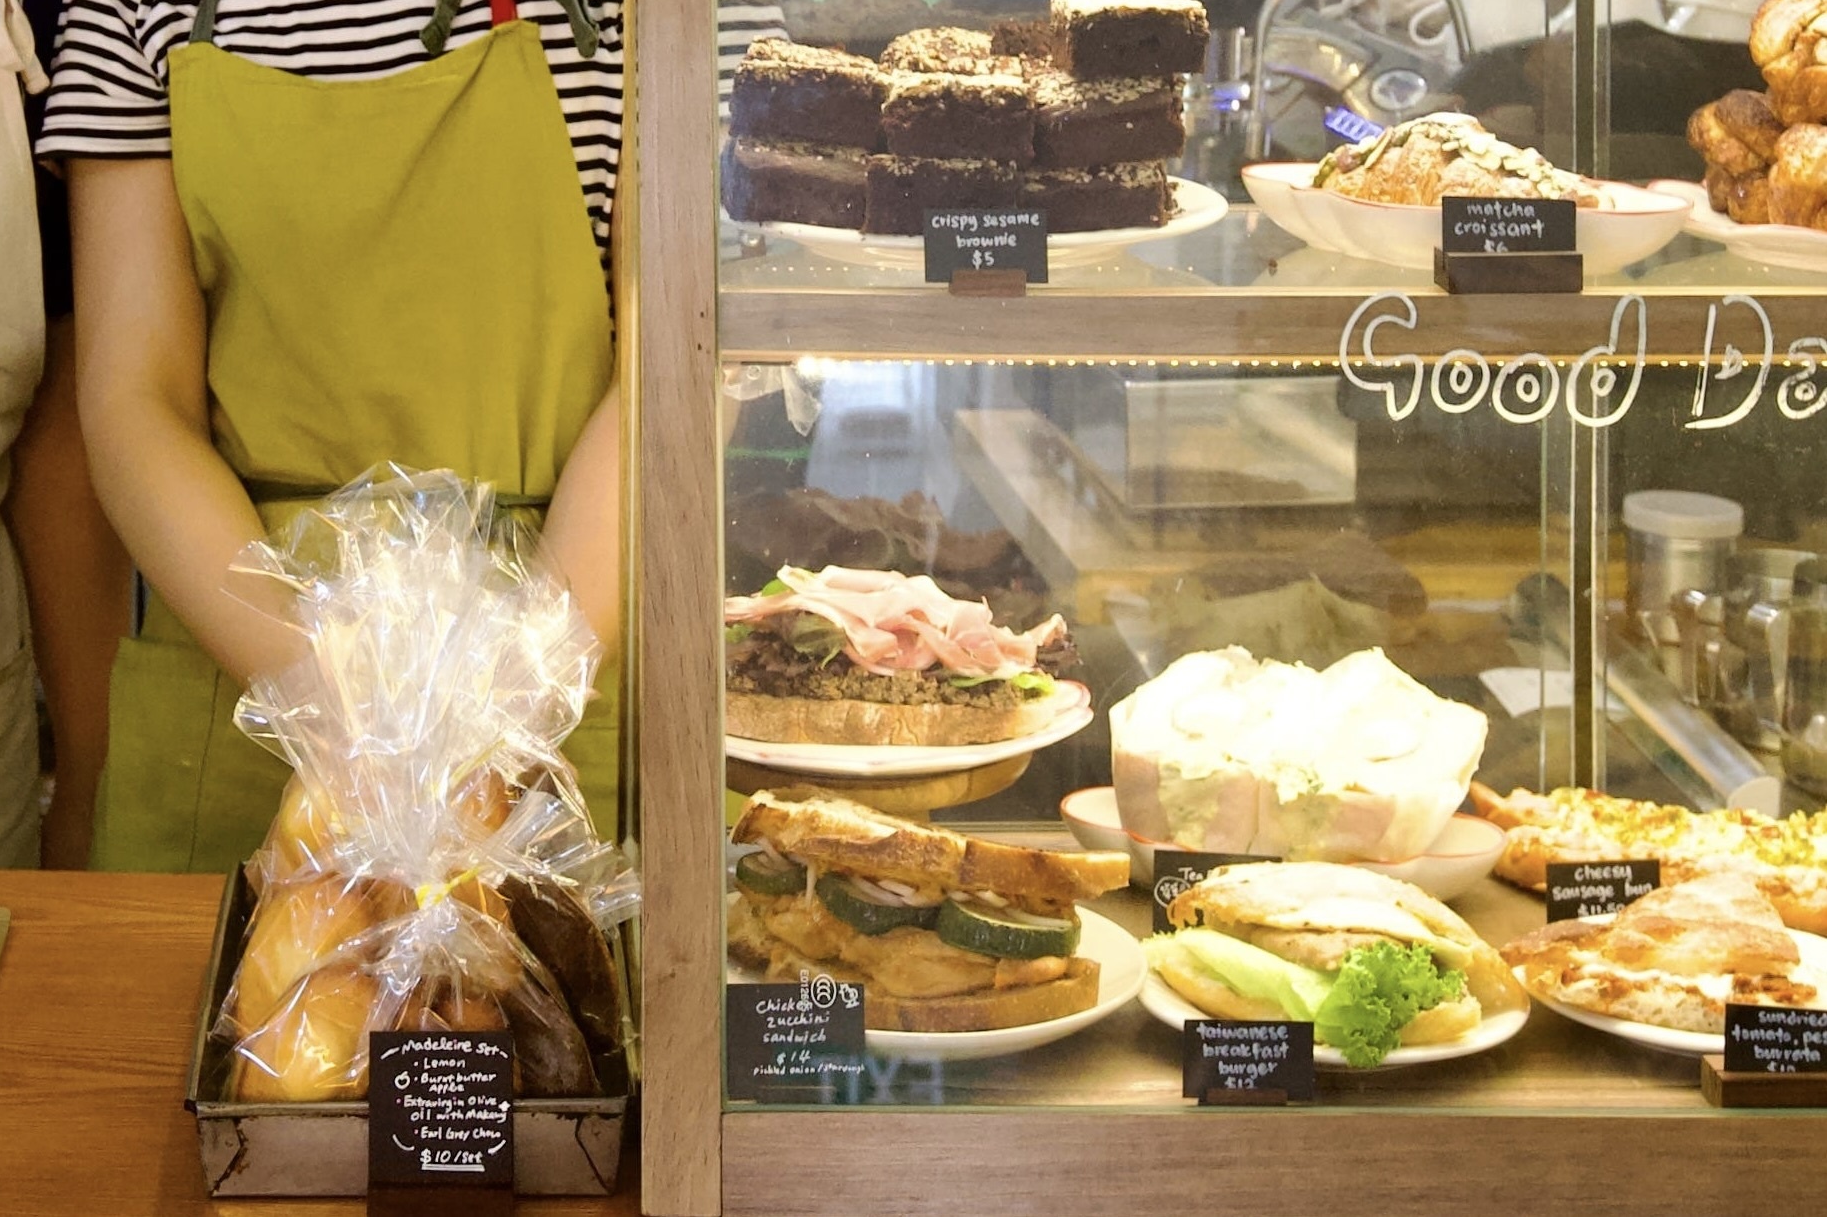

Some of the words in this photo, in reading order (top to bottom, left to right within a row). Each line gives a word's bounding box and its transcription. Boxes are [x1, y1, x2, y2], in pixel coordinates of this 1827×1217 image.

[1466, 200, 1535, 220] matcha
[931, 213, 978, 231] crispy
[983, 213, 1040, 228] sesame
[1454, 218, 1545, 239] croissant
[955, 232, 1017, 248] brownie
[971, 250, 995, 270] $5
[1339, 291, 1647, 428] Good
[1574, 864, 1633, 883] cheesy
[1552, 885, 1614, 903] sausage
[762, 1028, 827, 1046] sandwich
[1196, 1021, 1289, 1041] taiwanese
[401, 1036, 473, 1056] Madeleine
[423, 1057, 466, 1069] Lemon
[1218, 1060, 1278, 1080] burger
[436, 1109, 464, 1120] with
